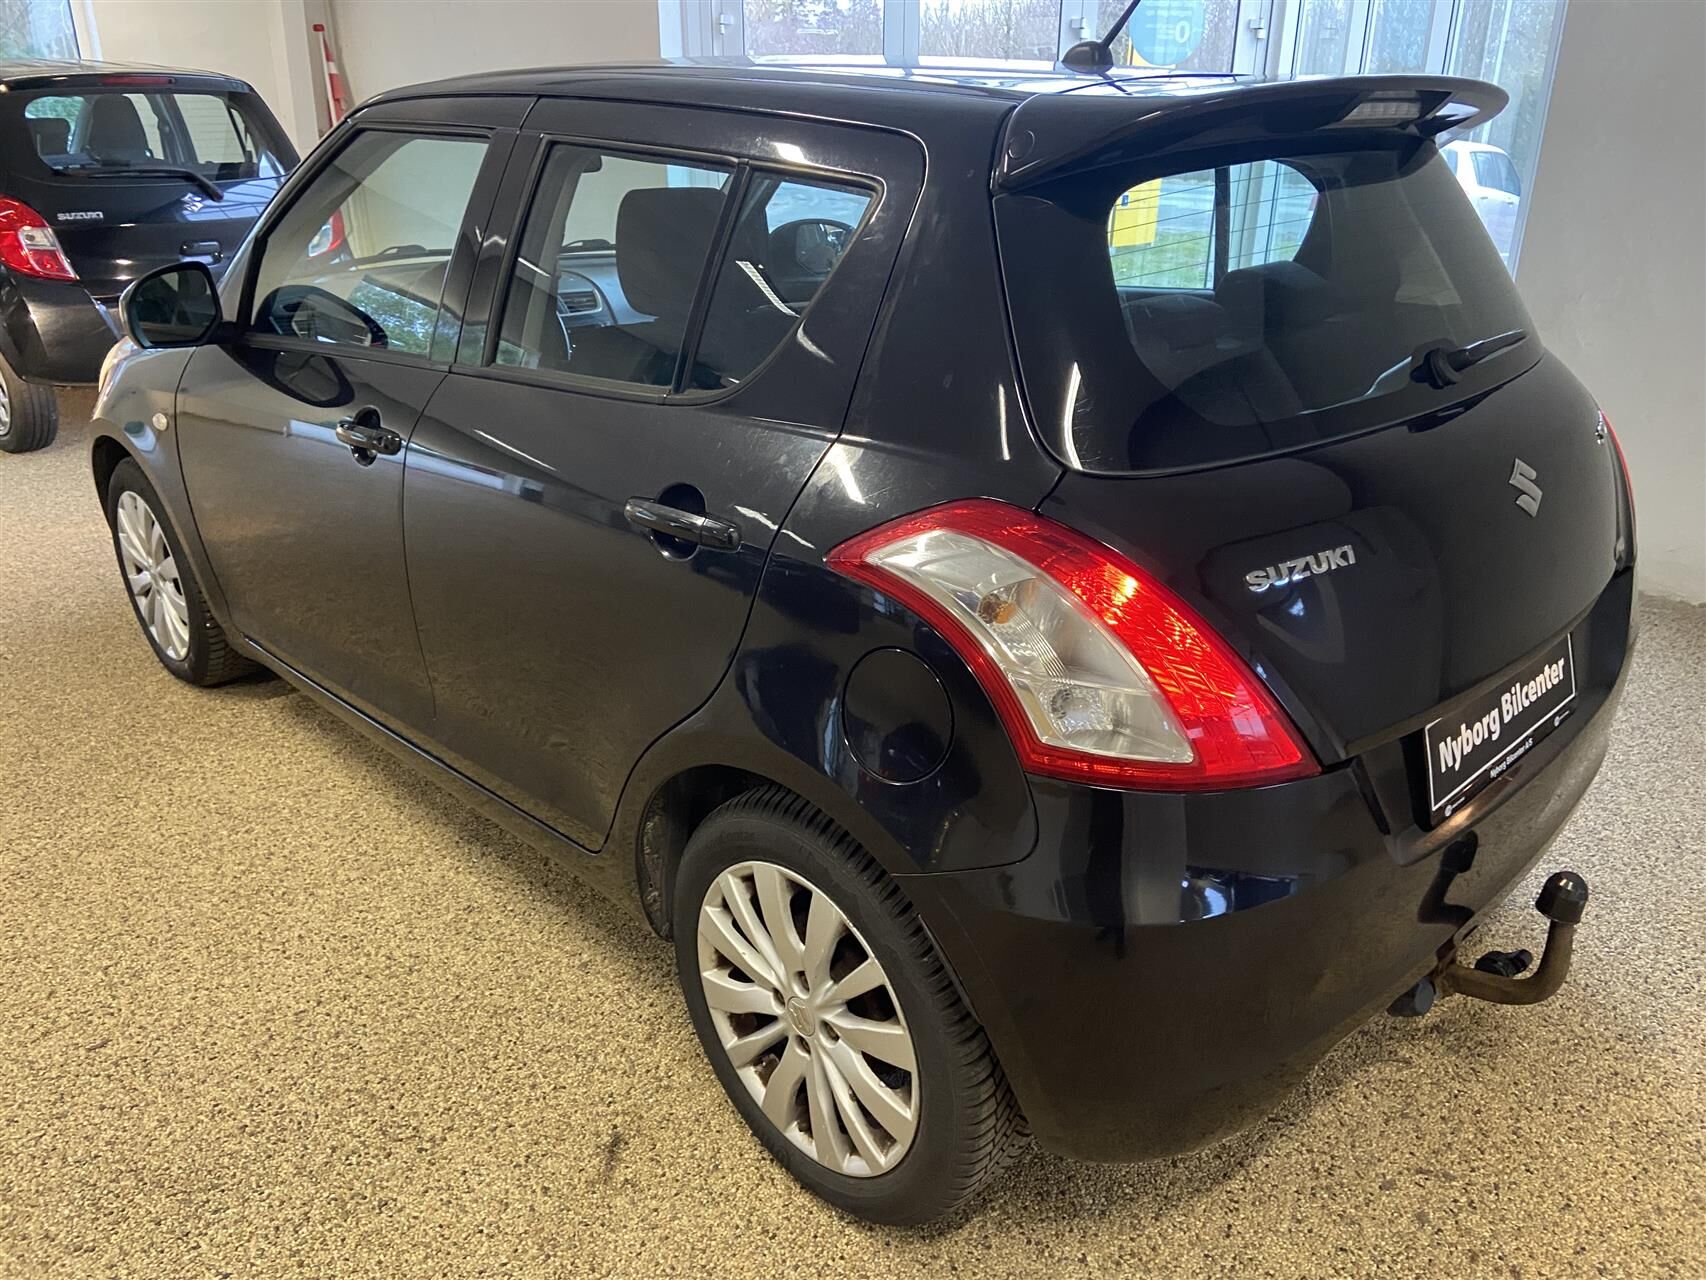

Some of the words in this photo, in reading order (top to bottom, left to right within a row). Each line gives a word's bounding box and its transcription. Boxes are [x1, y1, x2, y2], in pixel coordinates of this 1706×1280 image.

[57, 211, 104, 221] SUZUKI
[1245, 544, 1357, 592] SUZUKI
[1438, 707, 1501, 774] Nyborg
[1501, 657, 1565, 724] Bilcenter
